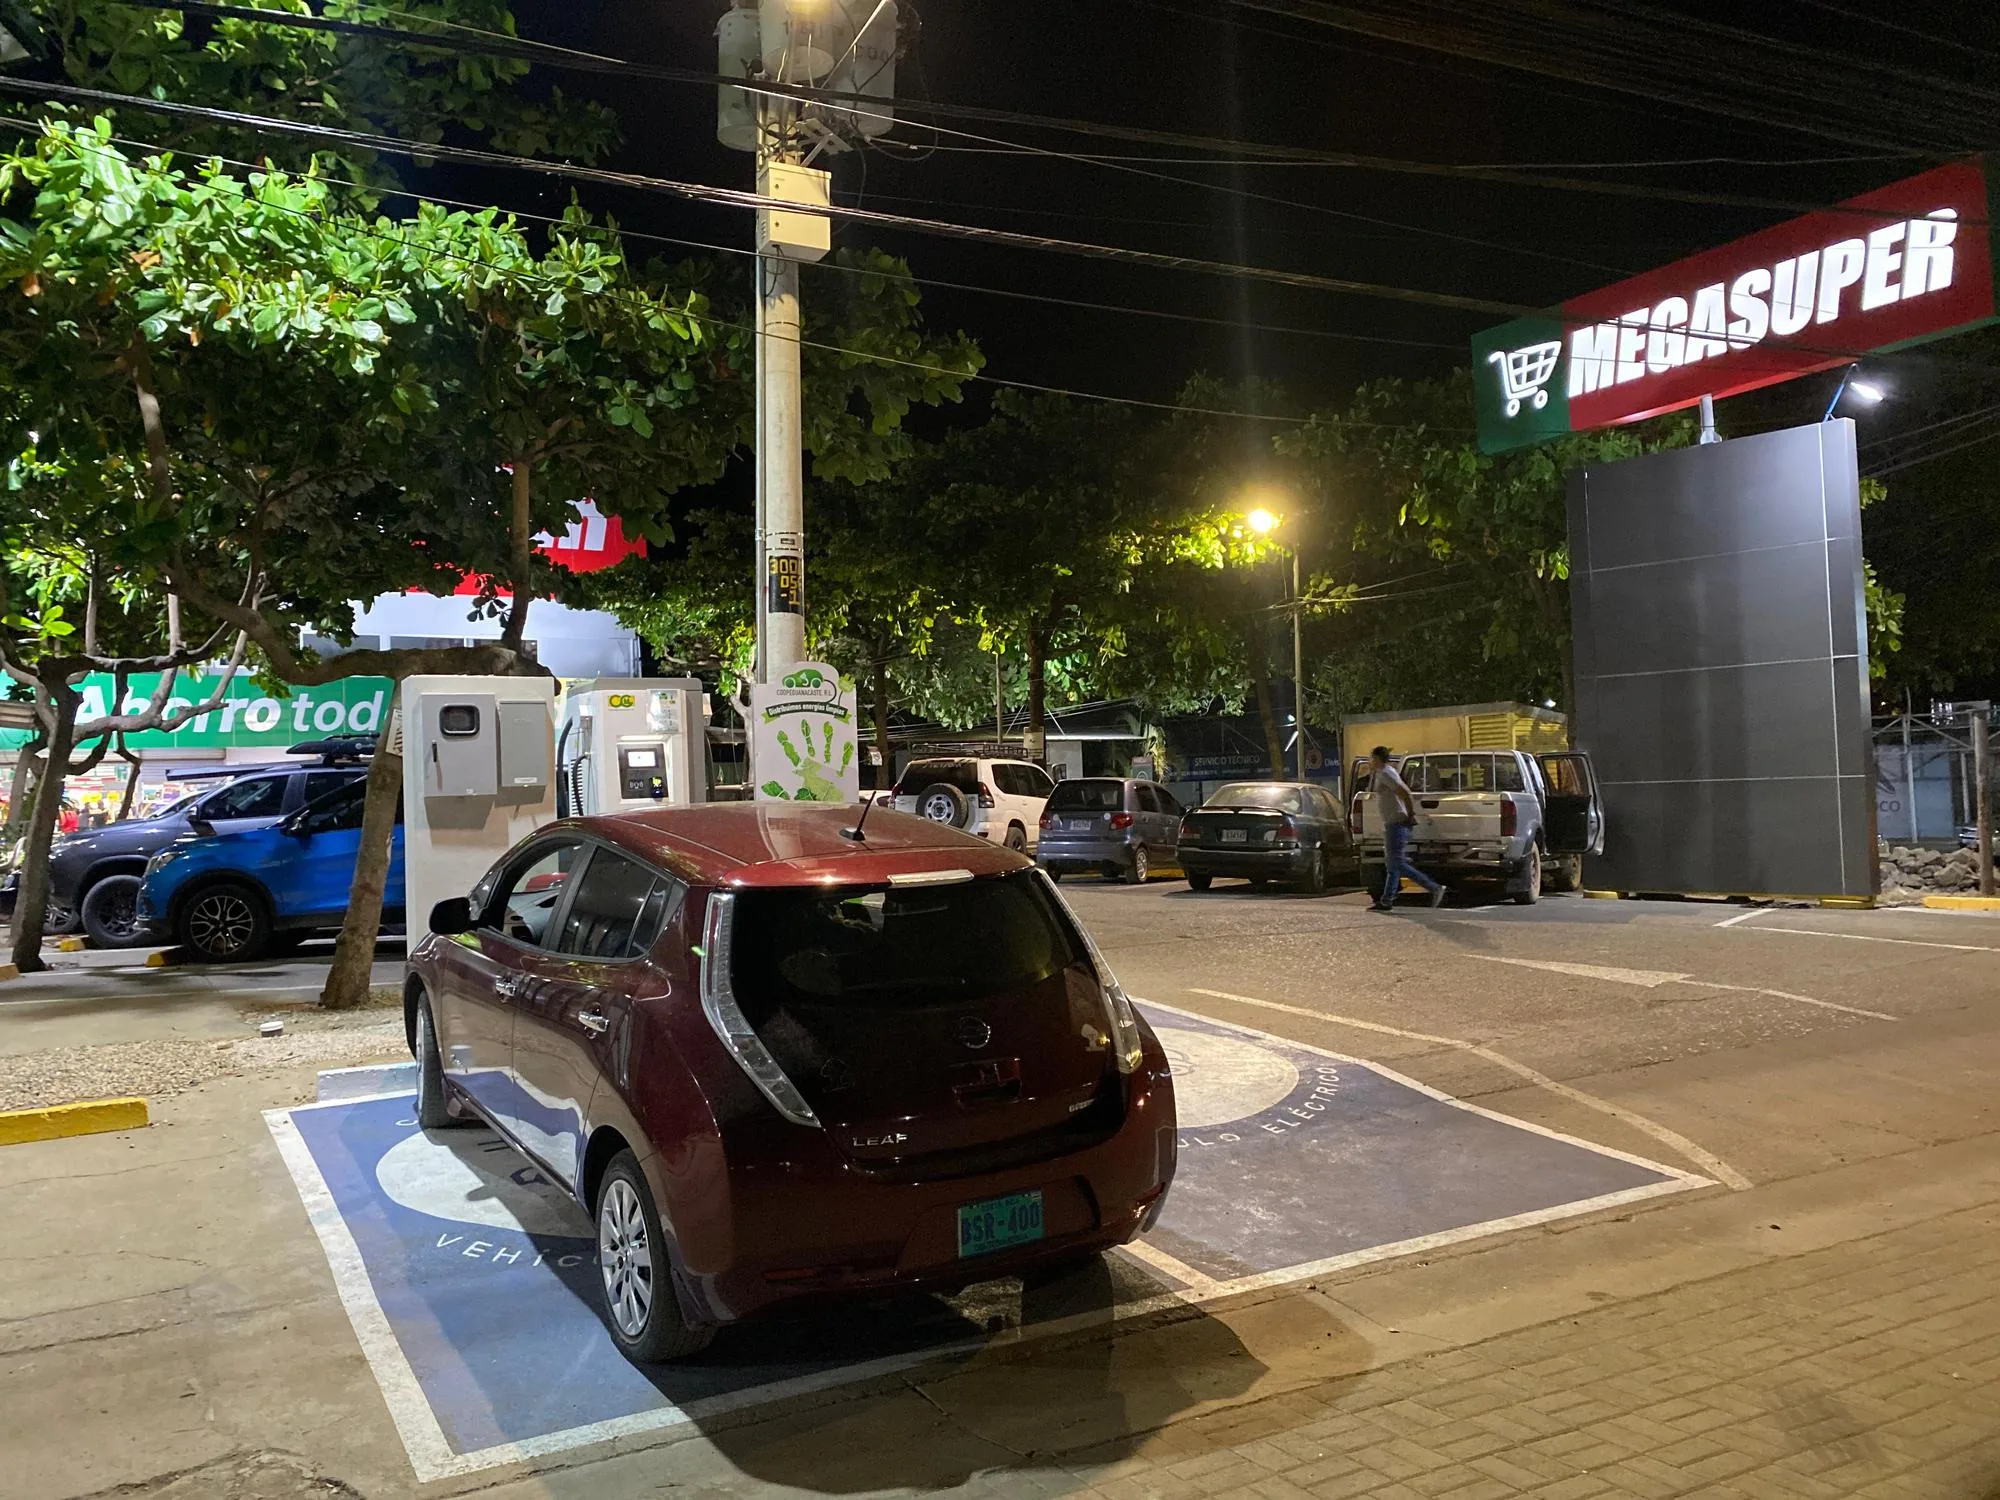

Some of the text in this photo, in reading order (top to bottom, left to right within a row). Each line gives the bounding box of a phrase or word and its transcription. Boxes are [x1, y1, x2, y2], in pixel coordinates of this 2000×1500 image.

[1568, 207, 1958, 398] MEGASUPER
[291, 690, 388, 732] tod
[1261, 1065, 1340, 1135] ELÉCTRICO
[852, 1132, 908, 1147] LEAF
[436, 1233, 598, 1268] VEHÍC
